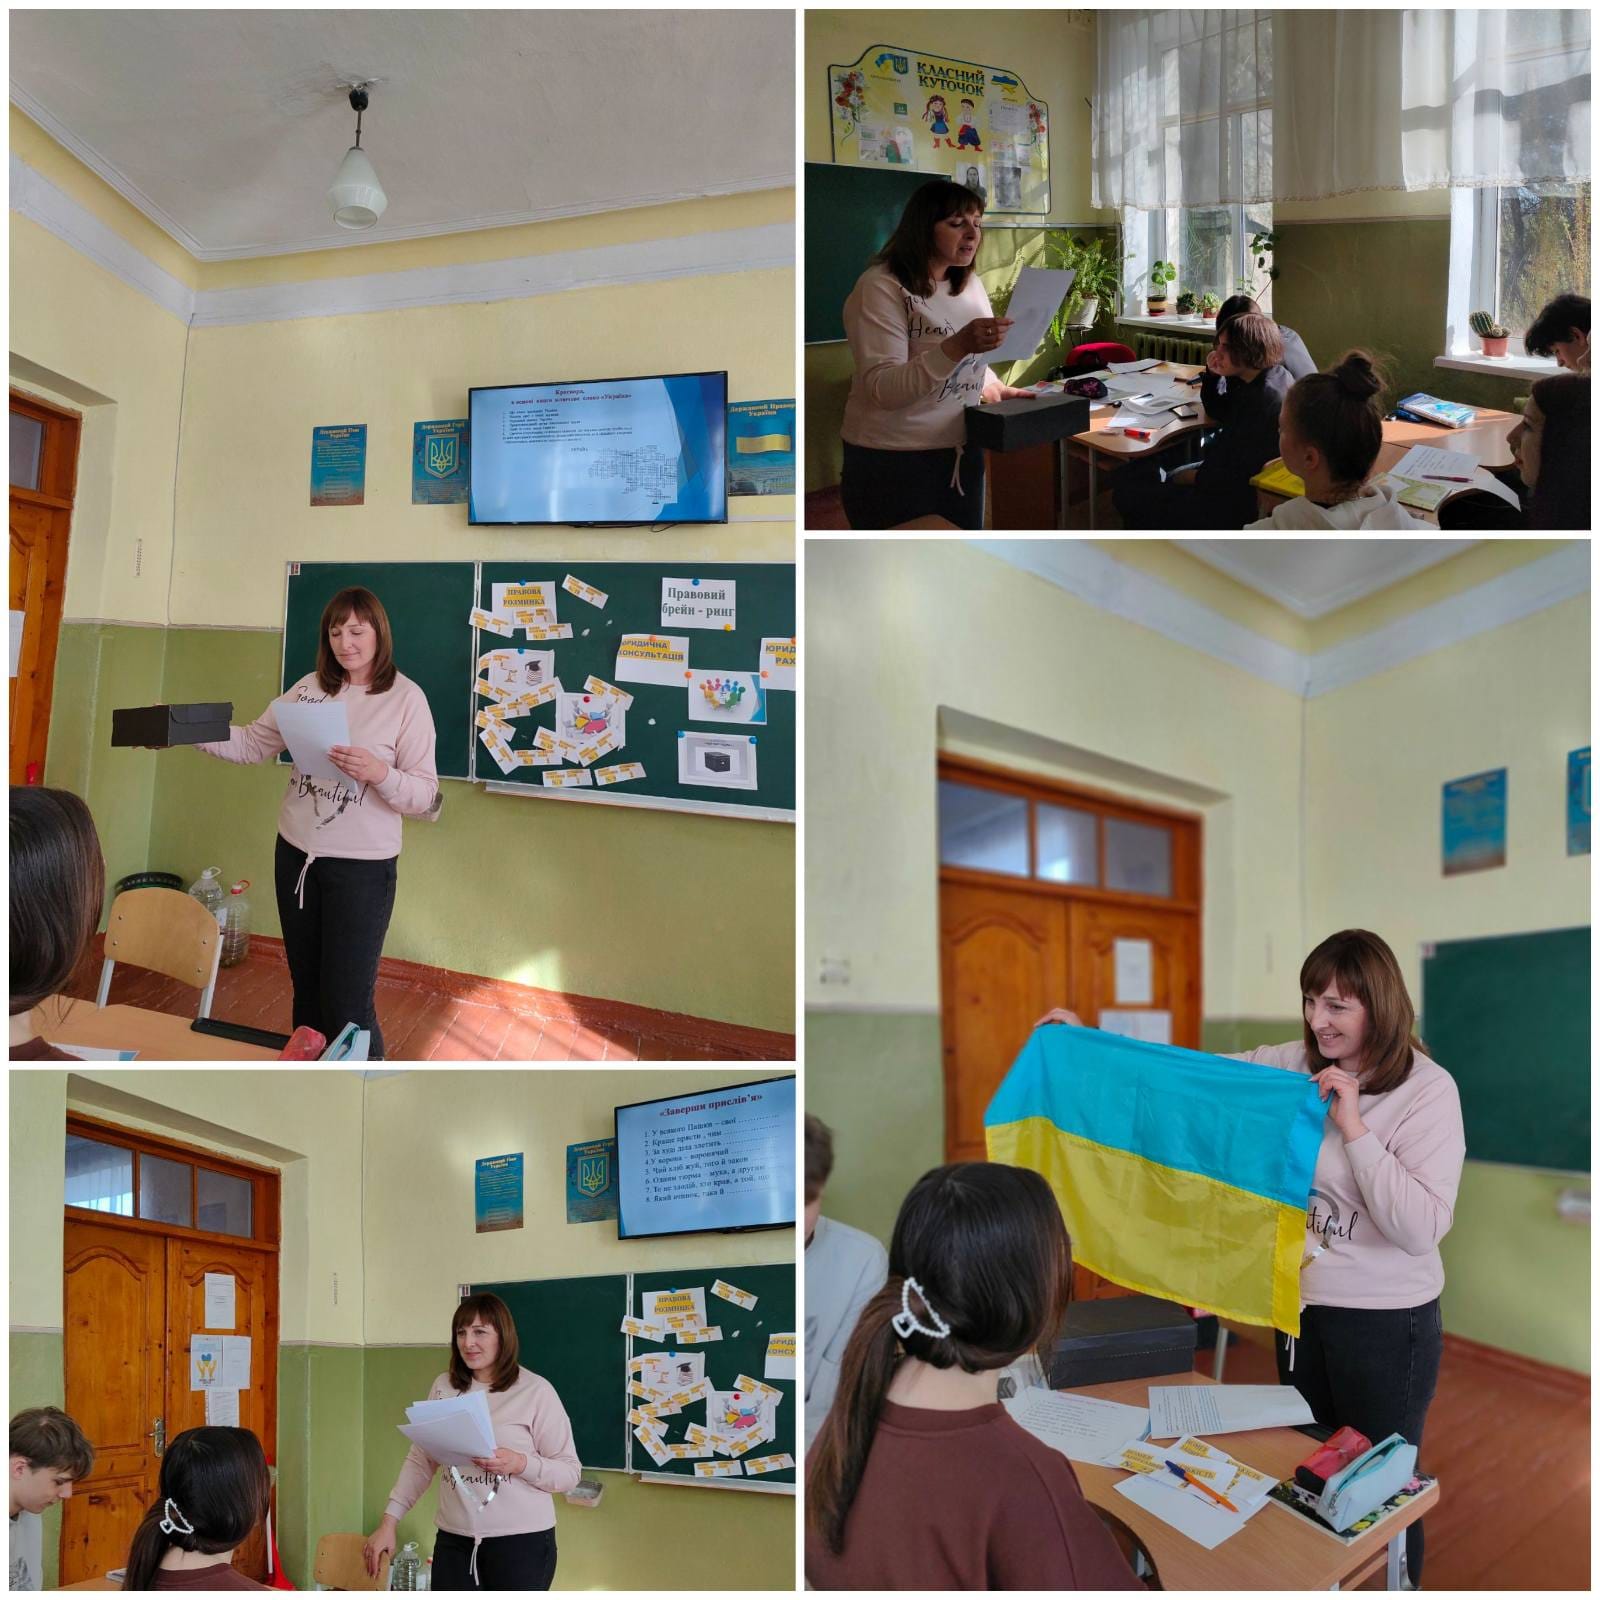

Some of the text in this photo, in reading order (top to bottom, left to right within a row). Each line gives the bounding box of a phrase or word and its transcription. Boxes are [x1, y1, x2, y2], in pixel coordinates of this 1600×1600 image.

[916, 62, 985, 84] КЛАСНИЙ
[918, 75, 985, 97] КУТОЧОК
[507, 588, 542, 596] ПРАВОВА
[667, 588, 726, 601] Правовий
[662, 602, 695, 616] брейн
[706, 607, 735, 618] ринг
[299, 775, 367, 805] Beautiful
[660, 1104, 705, 1117] «Заверши
